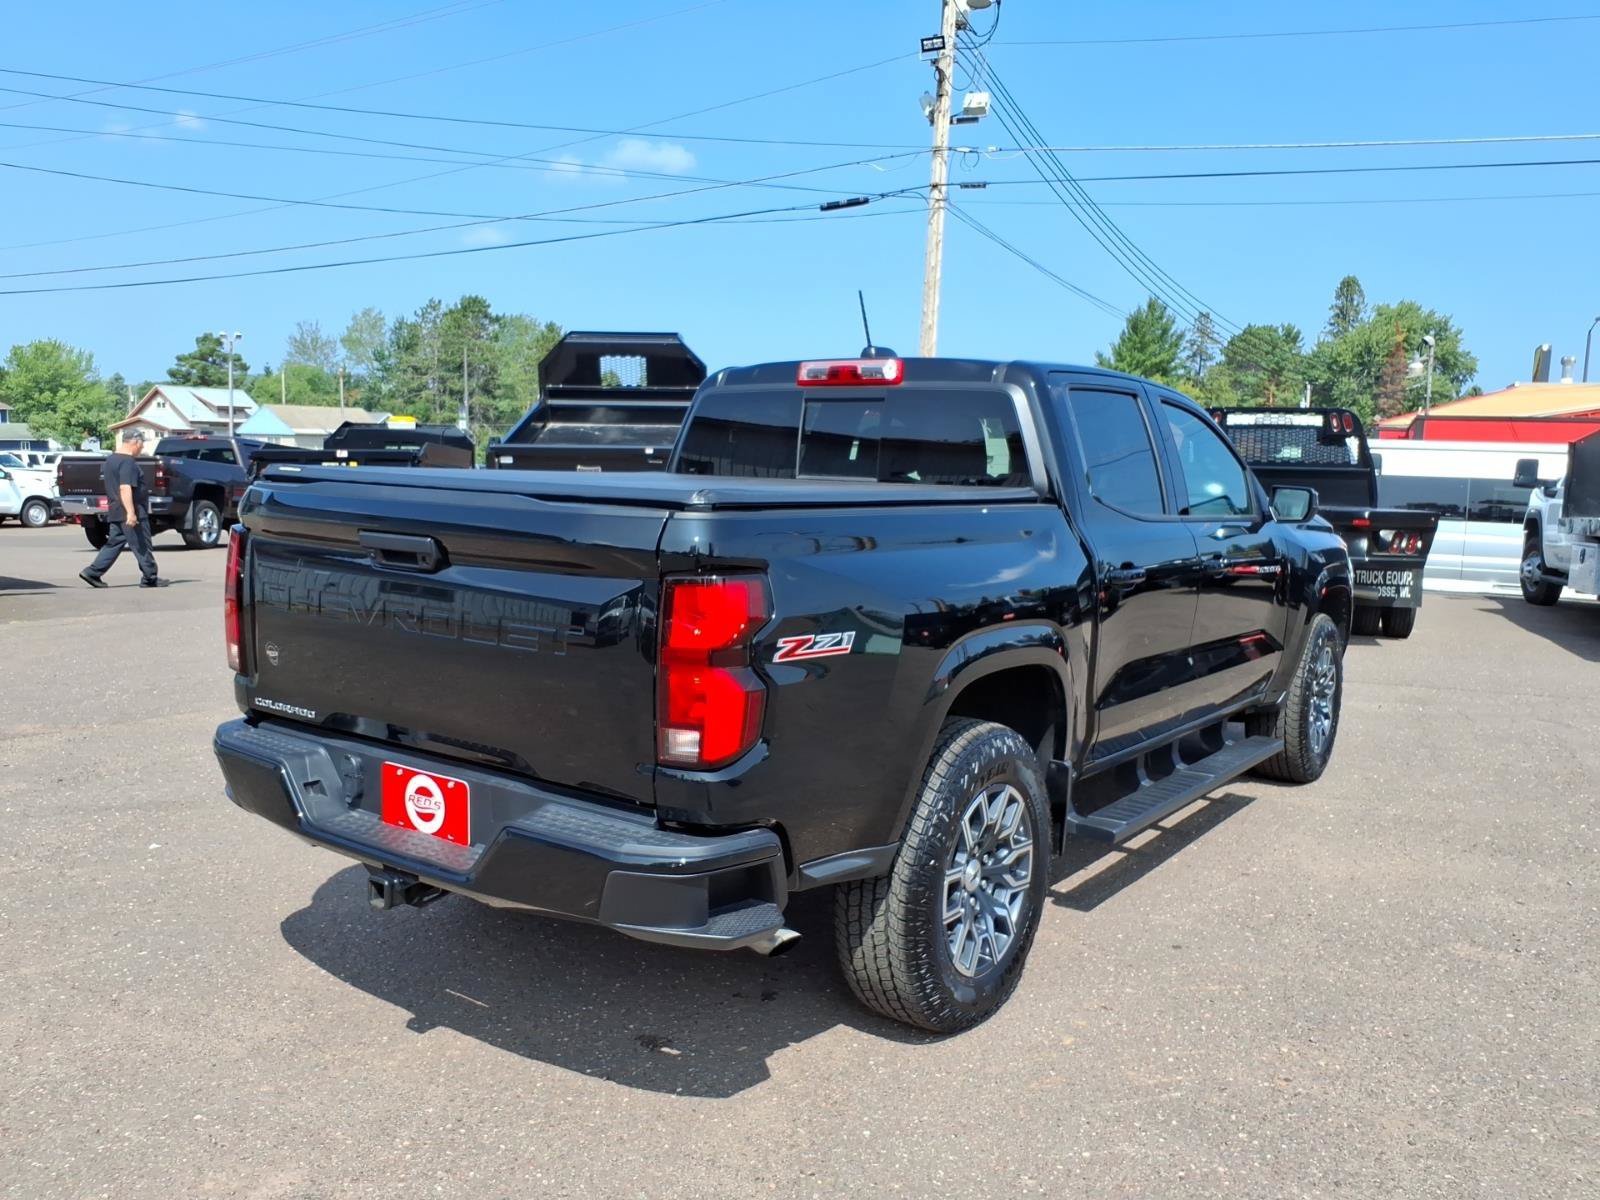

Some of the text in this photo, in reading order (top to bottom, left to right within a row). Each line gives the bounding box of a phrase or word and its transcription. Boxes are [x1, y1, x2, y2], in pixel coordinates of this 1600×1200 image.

[1355, 570, 1414, 586] TRUCK EQUIP.
[1375, 586, 1398, 599] OSSE,
[261, 581, 585, 656] CHEVROLET
[772, 630, 857, 663] Z71
[254, 697, 316, 718] COLORADO
